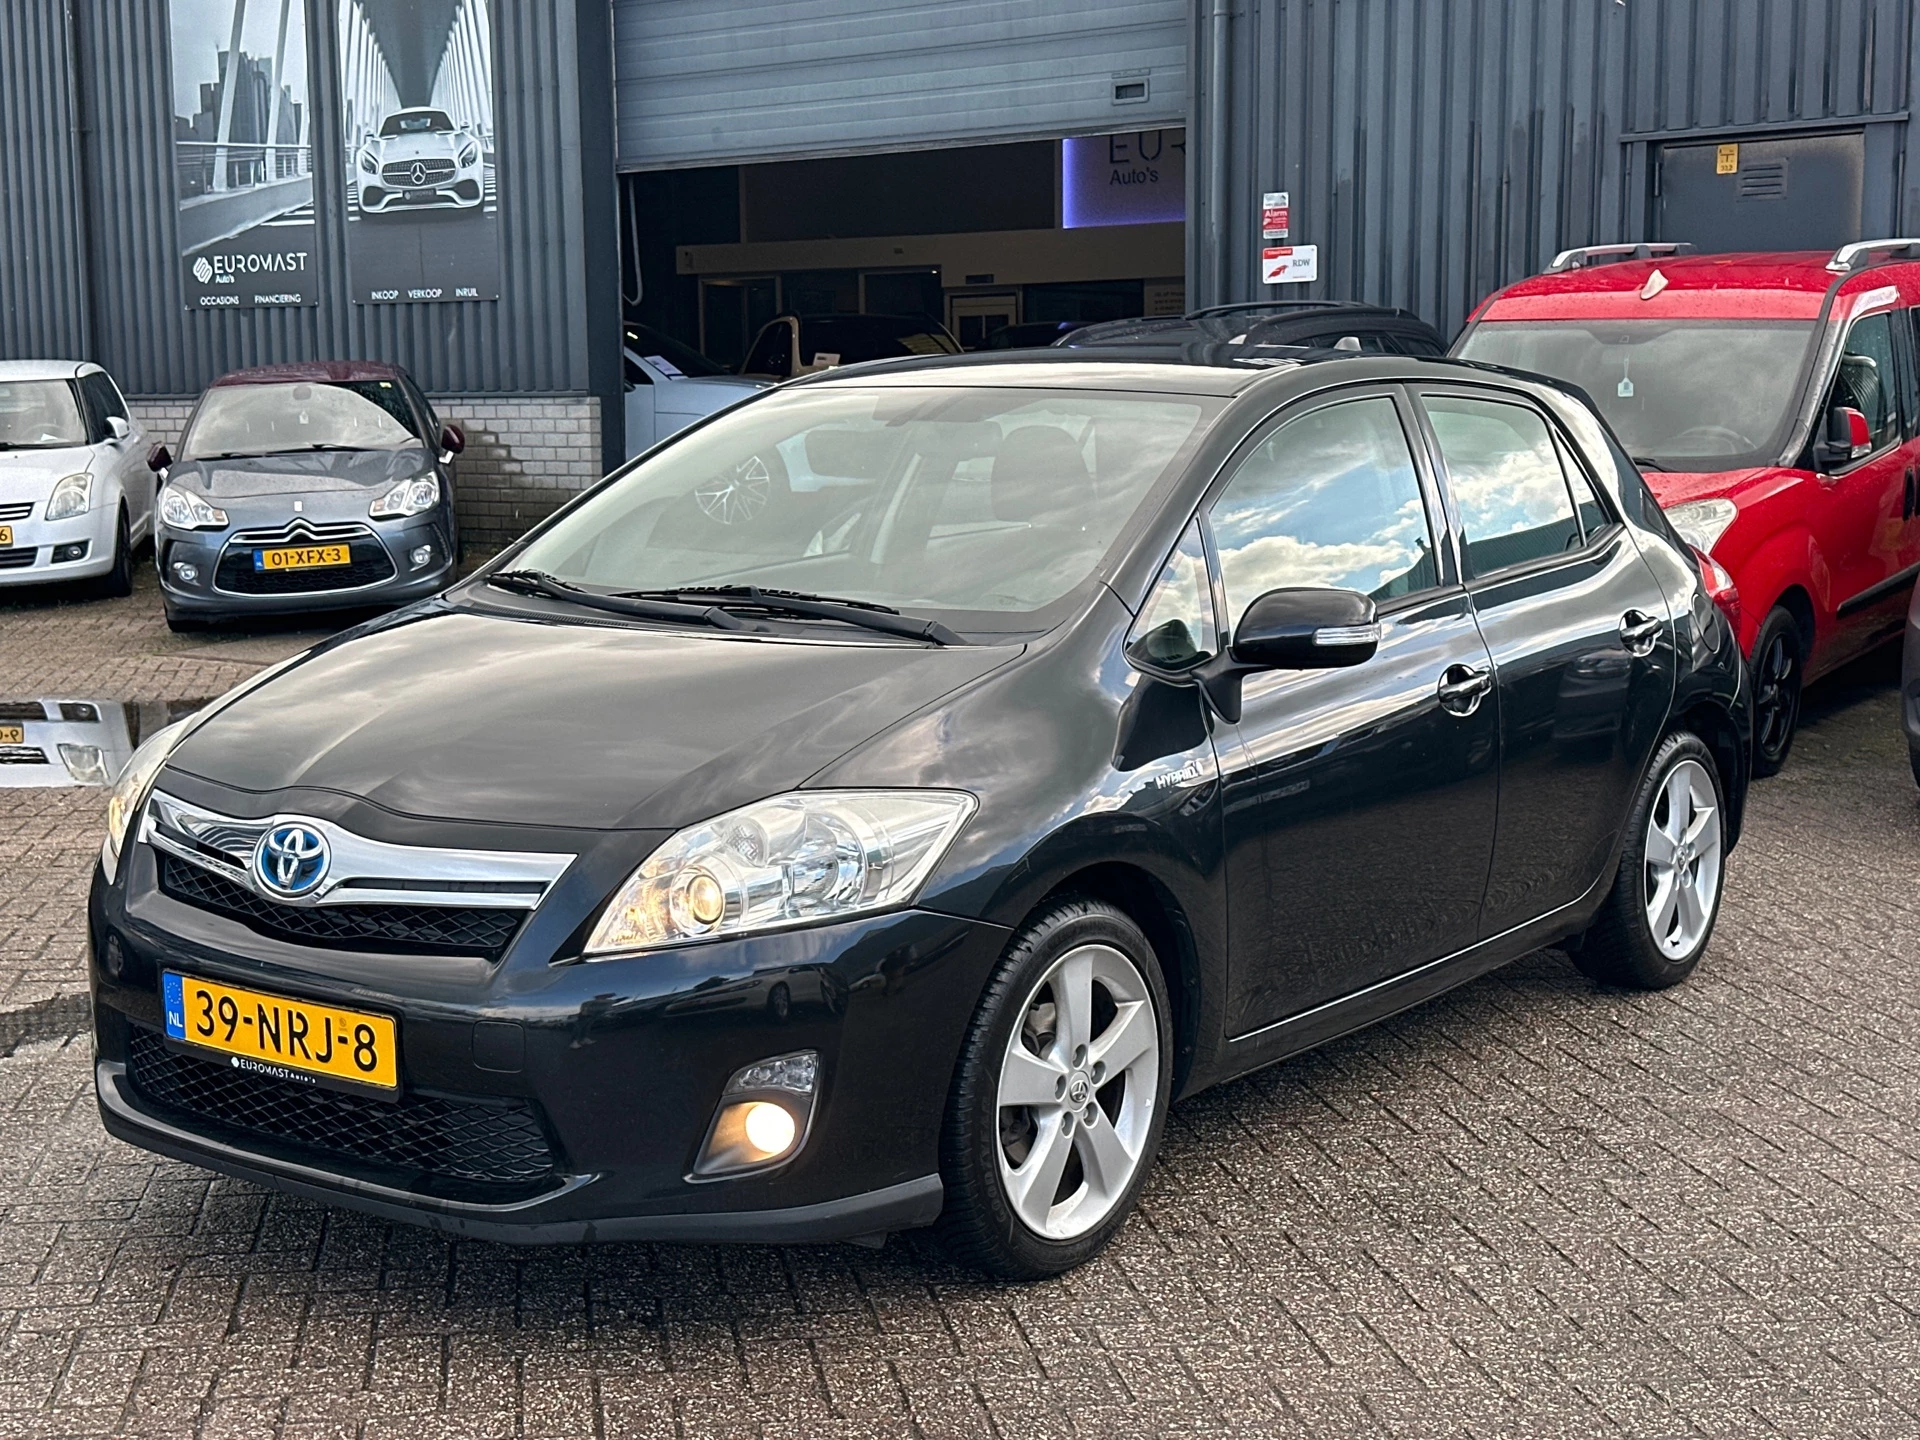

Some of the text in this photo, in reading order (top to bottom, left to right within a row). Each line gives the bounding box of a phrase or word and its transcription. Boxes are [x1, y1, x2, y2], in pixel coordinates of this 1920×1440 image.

[1109, 166, 1159, 185] Auto's
[1264, 209, 1288, 218] Alarm
[213, 253, 307, 273] EUROMAST
[1292, 259, 1311, 267] RDW
[215, 274, 235, 283] Auto's
[200, 293, 302, 306] OCCASIONS FINANCIERING
[371, 287, 479, 300] INKOOP VERKOOP INRUIL
[271, 548, 341, 566] 01-XFX-3
[1155, 766, 1199, 790] HYBRID
[168, 989, 378, 1072] NL 39-NRJ-8
[240, 1058, 290, 1079] EUROMAST
